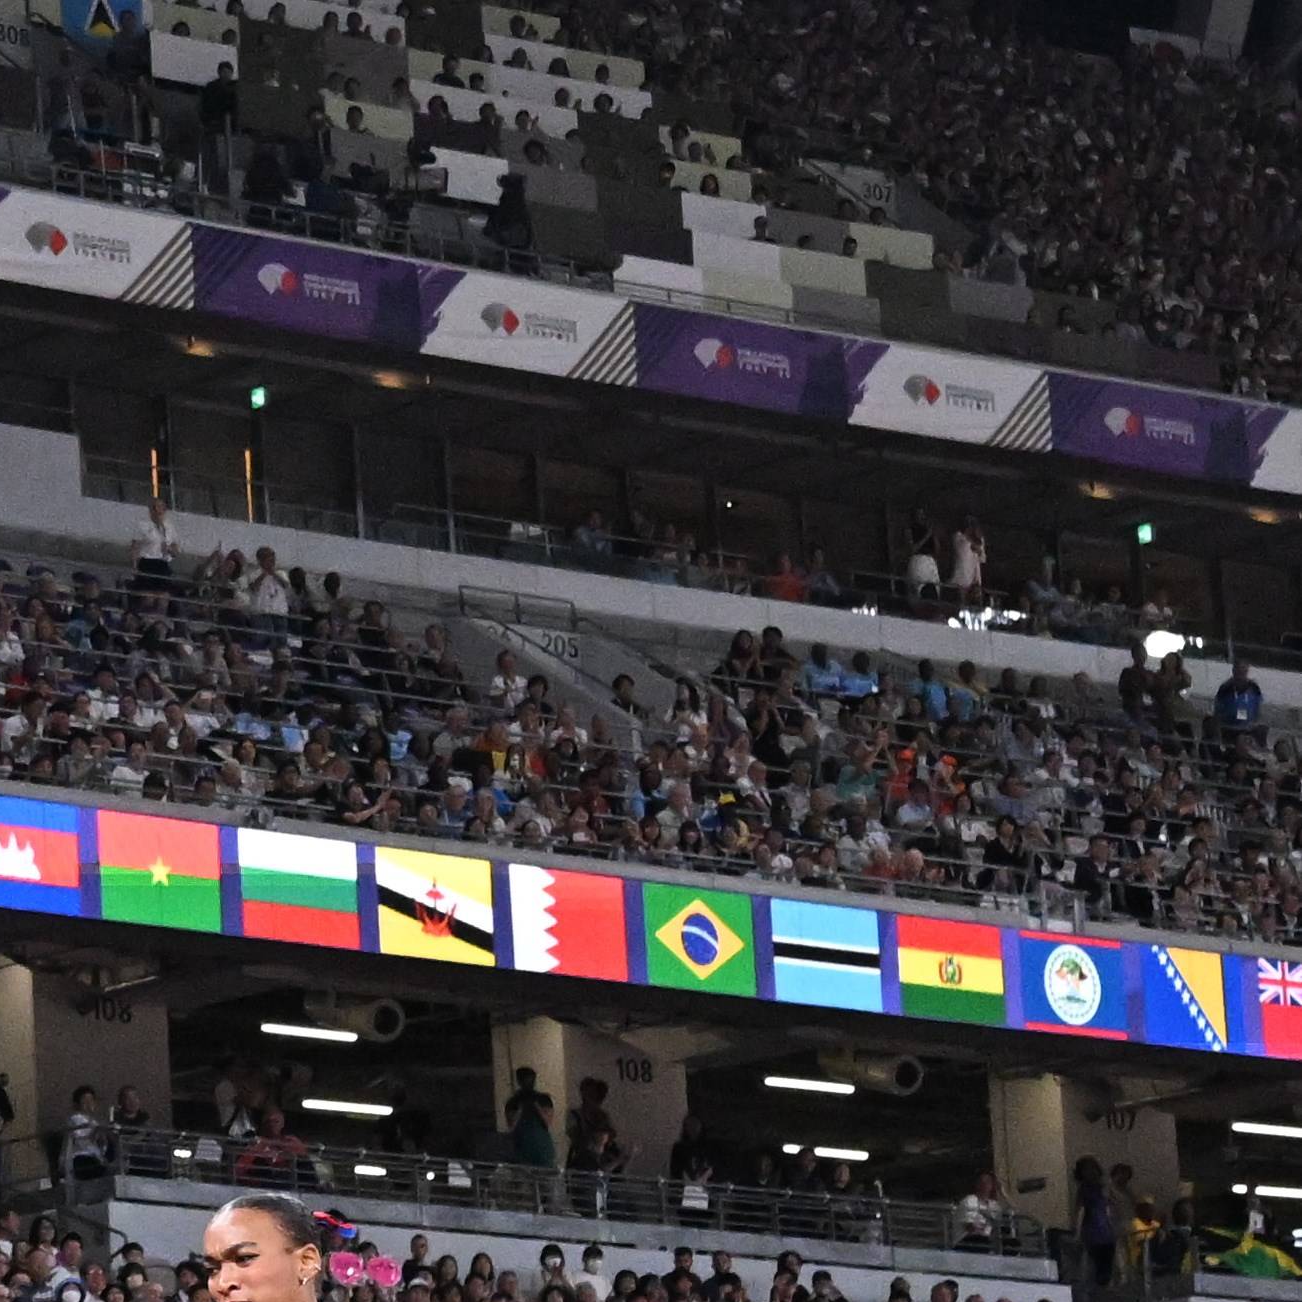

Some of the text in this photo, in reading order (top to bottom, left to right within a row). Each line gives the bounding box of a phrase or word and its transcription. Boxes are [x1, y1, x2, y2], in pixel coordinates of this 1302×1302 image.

[863, 183, 892, 204] 307
[541, 634, 579, 660] 205
[617, 1057, 653, 1084] 108
